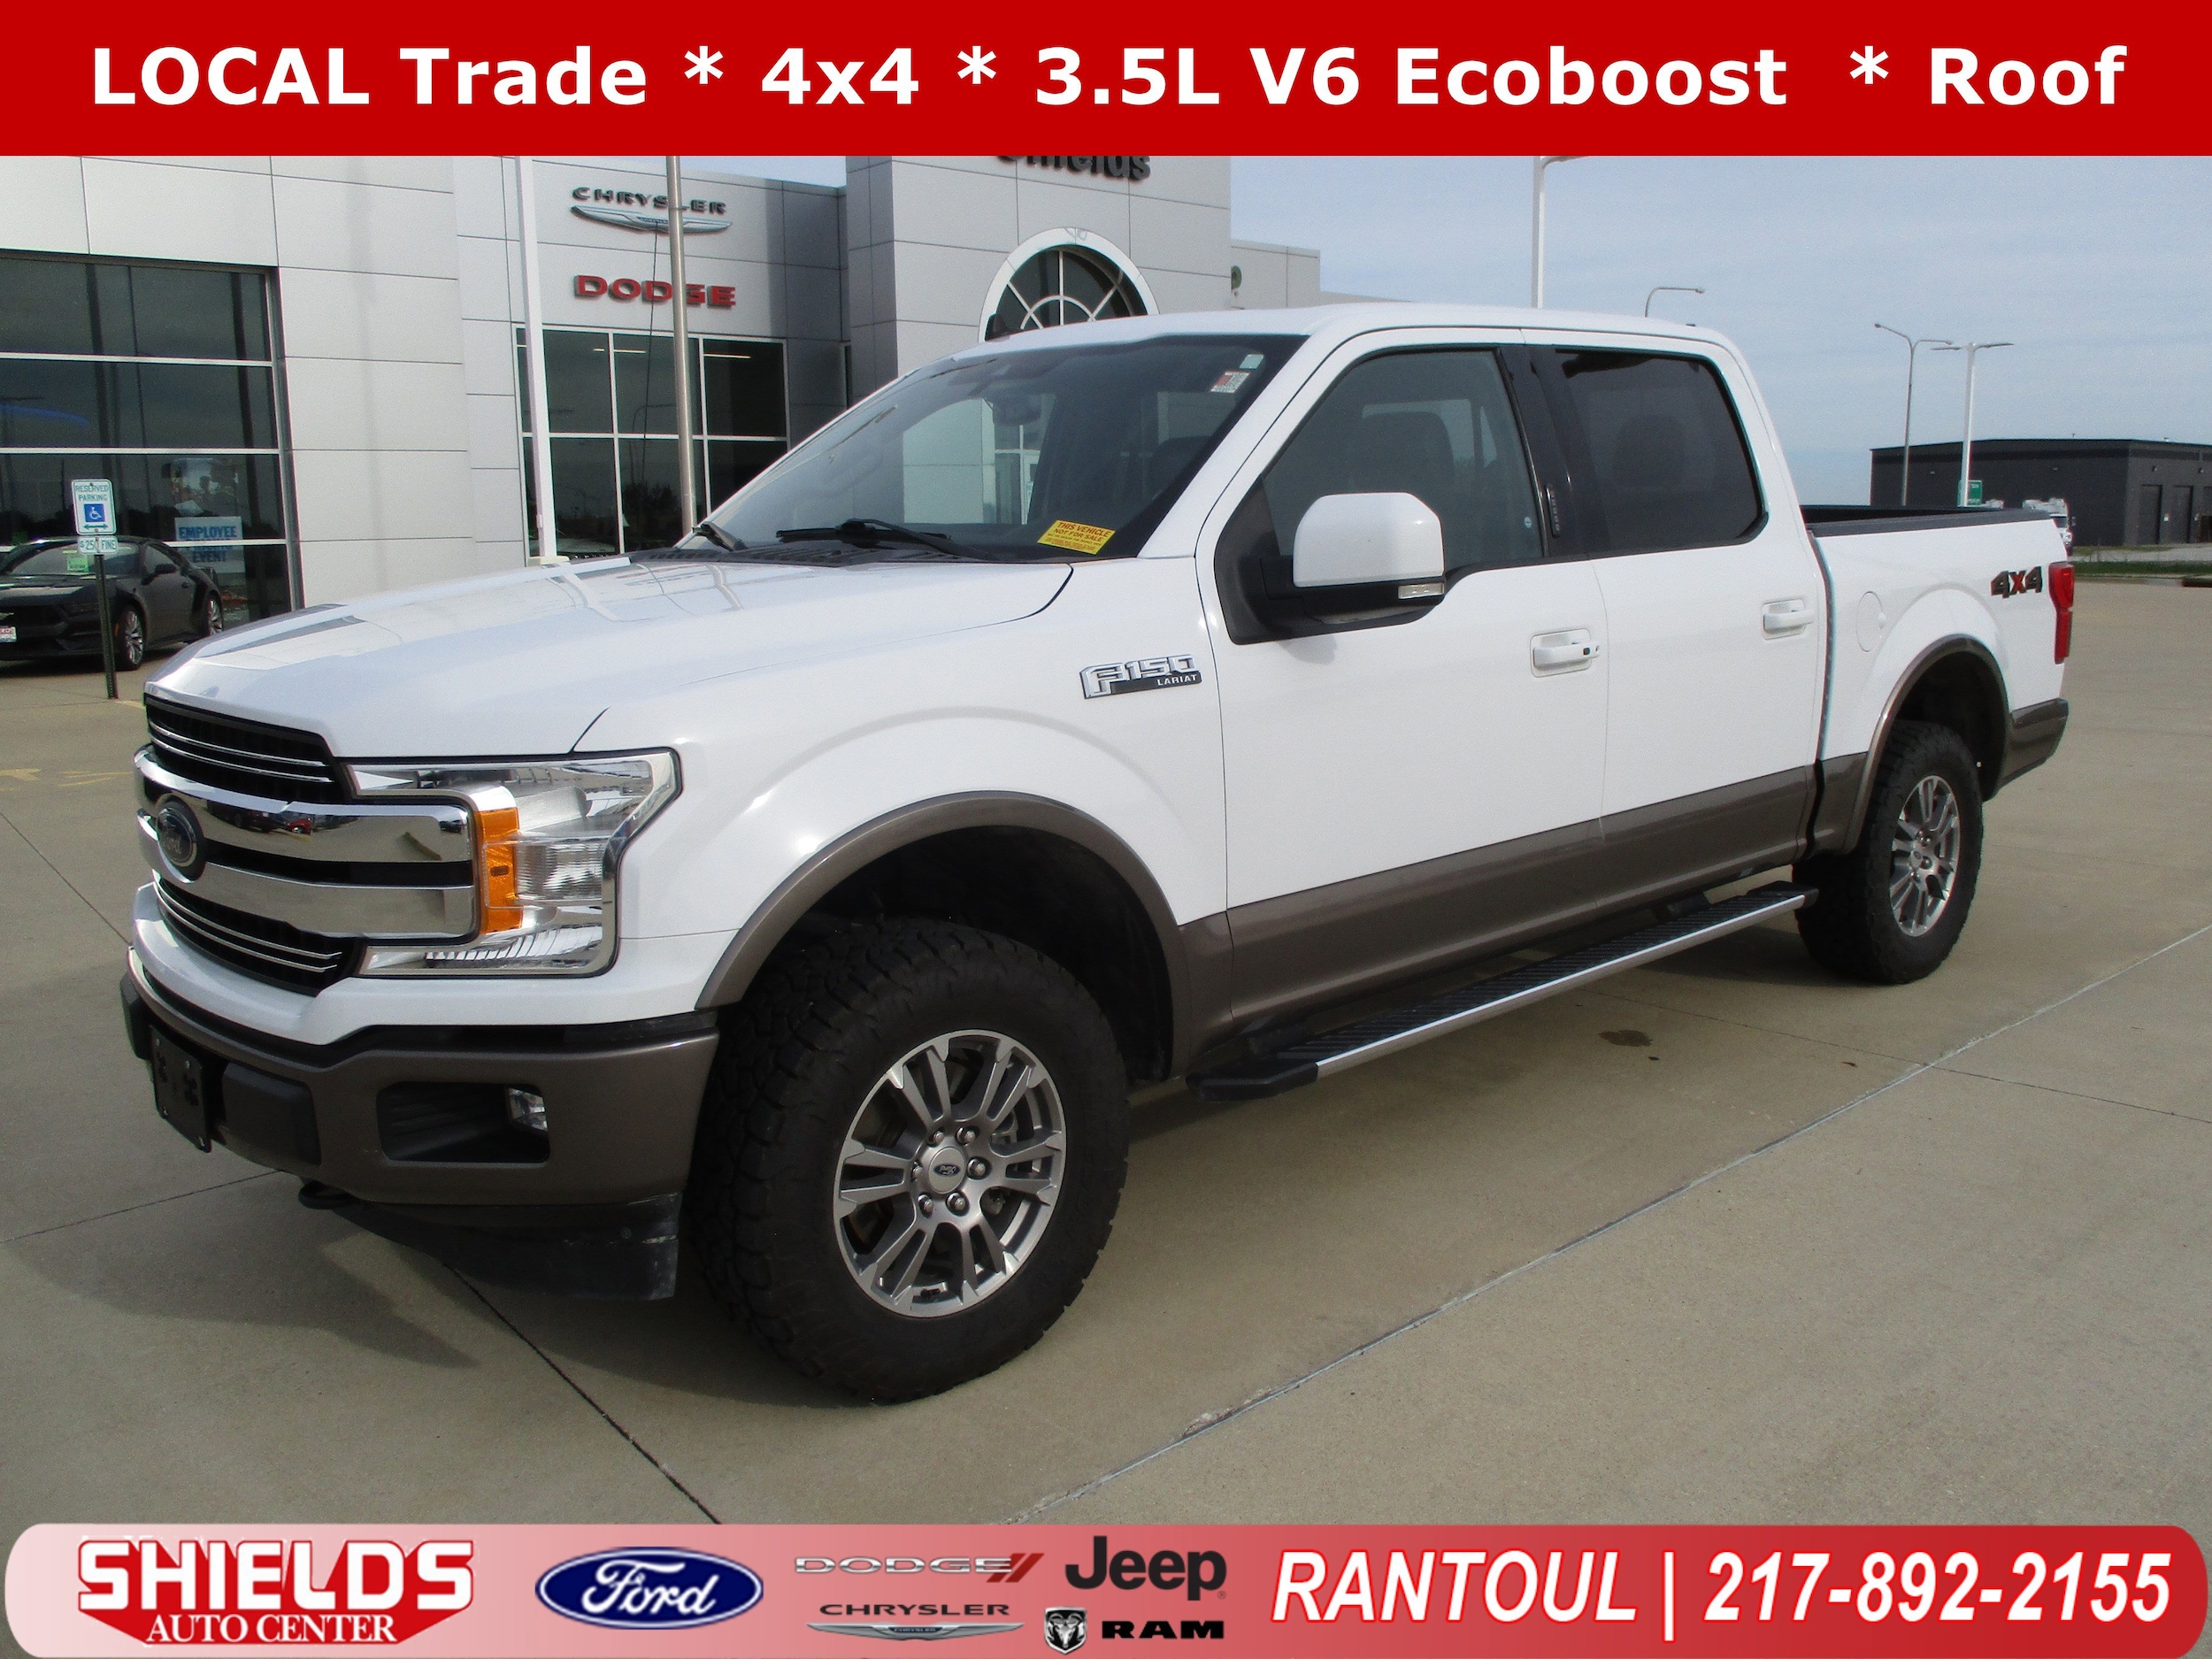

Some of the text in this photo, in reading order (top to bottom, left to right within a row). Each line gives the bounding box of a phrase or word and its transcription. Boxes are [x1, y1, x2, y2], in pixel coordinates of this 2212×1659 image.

[179, 526, 237, 539] EMPLOYEE
[1057, 522, 1111, 538] THIS VEHICLE
[1085, 534, 1103, 542] SALE
[102, 540, 117, 550] FINE
[192, 550, 227, 563] EVENT
[1156, 673, 1197, 687] LARIAT
